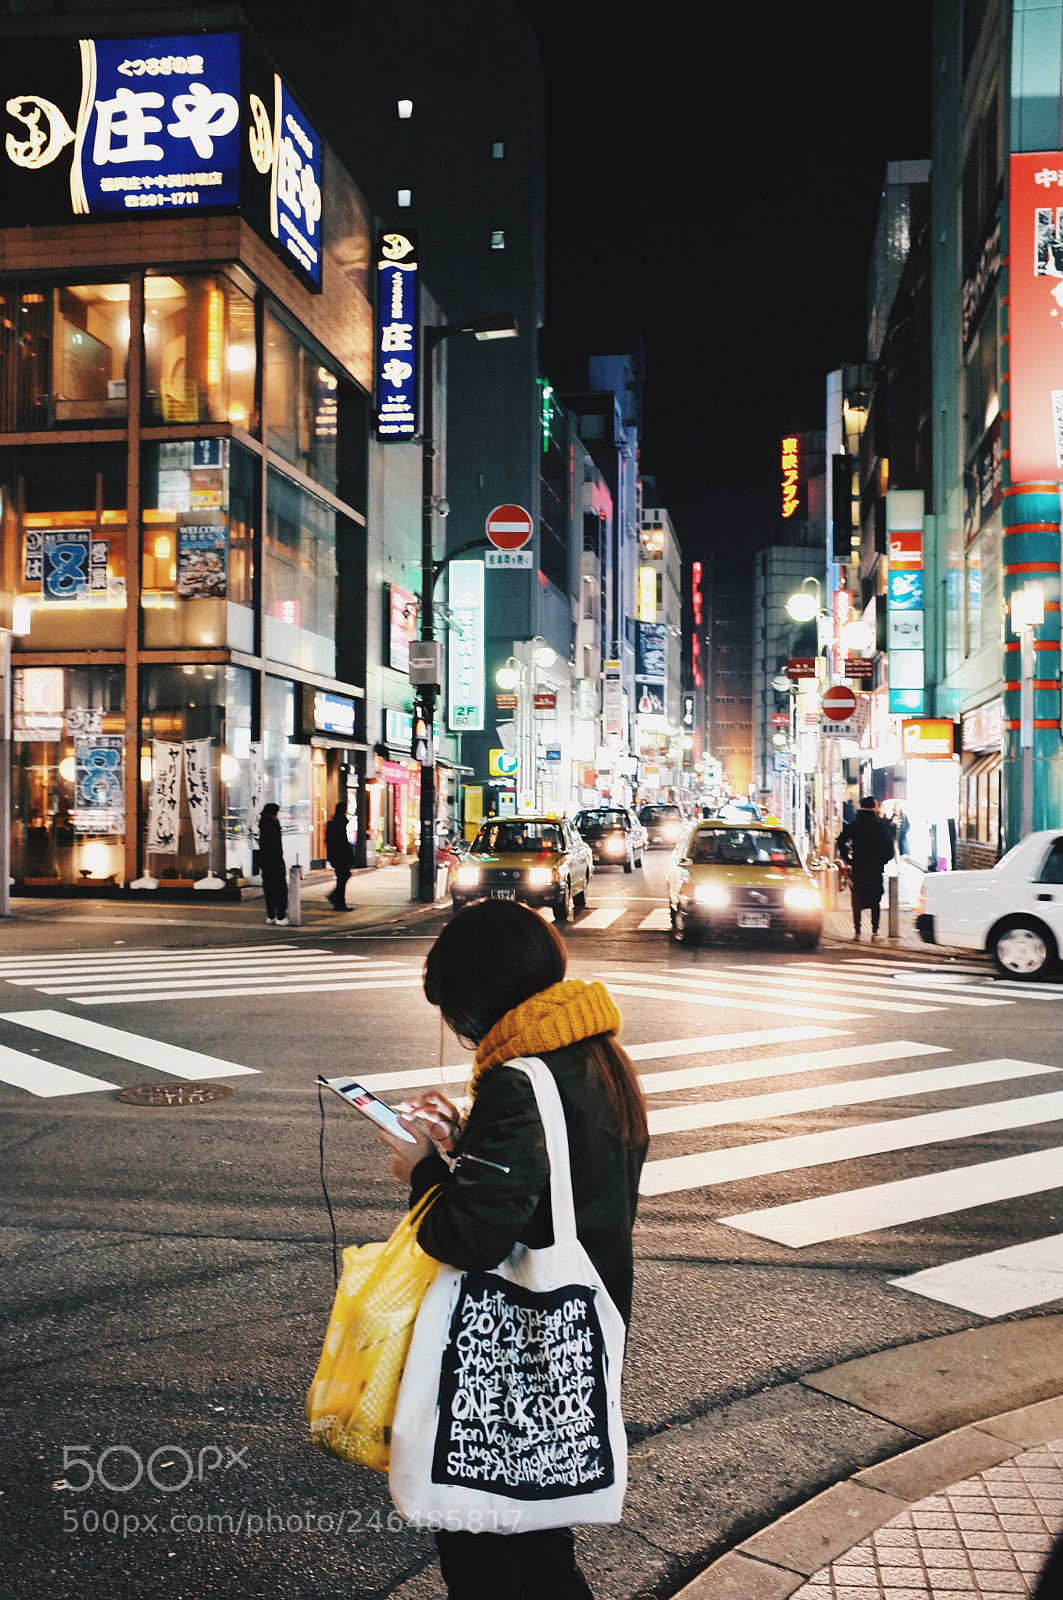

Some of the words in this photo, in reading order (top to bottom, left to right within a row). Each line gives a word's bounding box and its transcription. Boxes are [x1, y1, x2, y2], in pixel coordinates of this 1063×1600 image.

[93, 83, 240, 166] 庄や
[278, 136, 322, 236] 庄や
[381, 322, 413, 389] 庄や
[781, 437, 800, 519] 東映プラザ
[47, 543, 88, 597] 8
[456, 707, 476, 716] 2F
[562, 1298, 588, 1322] Off
[456, 1331, 492, 1354] One
[461, 1312, 531, 1350] 20/20
[539, 1326, 595, 1361] Tonight
[562, 1321, 575, 1340] in
[457, 1349, 498, 1375] Way
[453, 1366, 503, 1393] Ticket
[558, 1371, 596, 1396] Listen
[450, 1387, 504, 1424] ONE
[503, 1394, 535, 1430] OK
[537, 1388, 596, 1432] ROCK
[447, 1451, 492, 1481] Start
[467, 1444, 502, 1467] was
